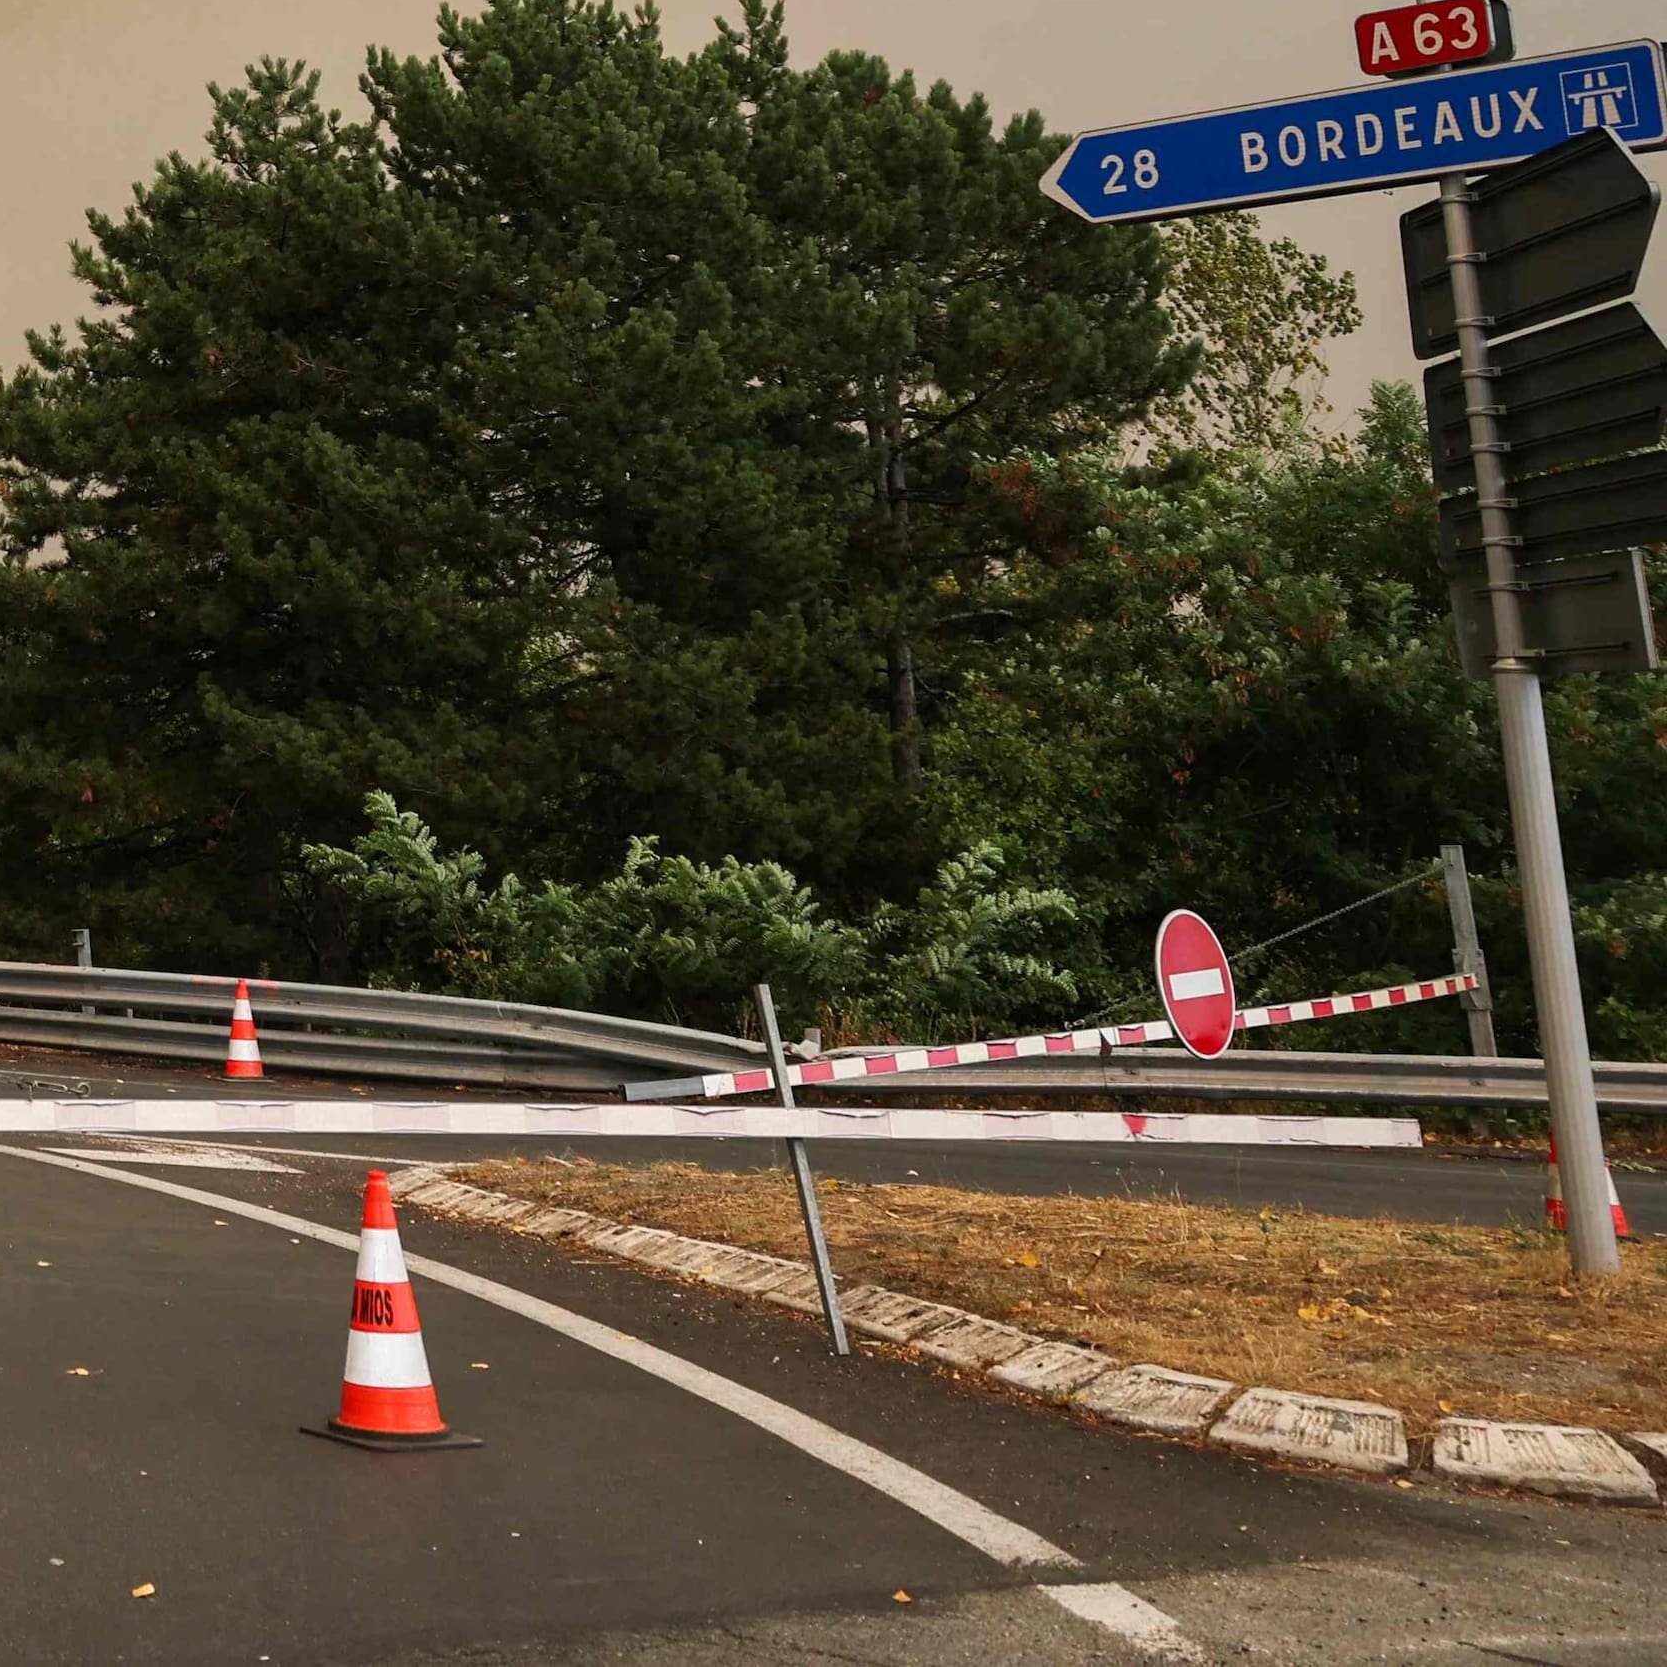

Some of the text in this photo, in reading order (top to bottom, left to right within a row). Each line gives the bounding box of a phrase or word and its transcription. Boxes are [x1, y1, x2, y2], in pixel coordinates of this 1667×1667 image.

[1370, 6, 1479, 65] A 63
[1099, 86, 1546, 196] 28 BORDEAUX
